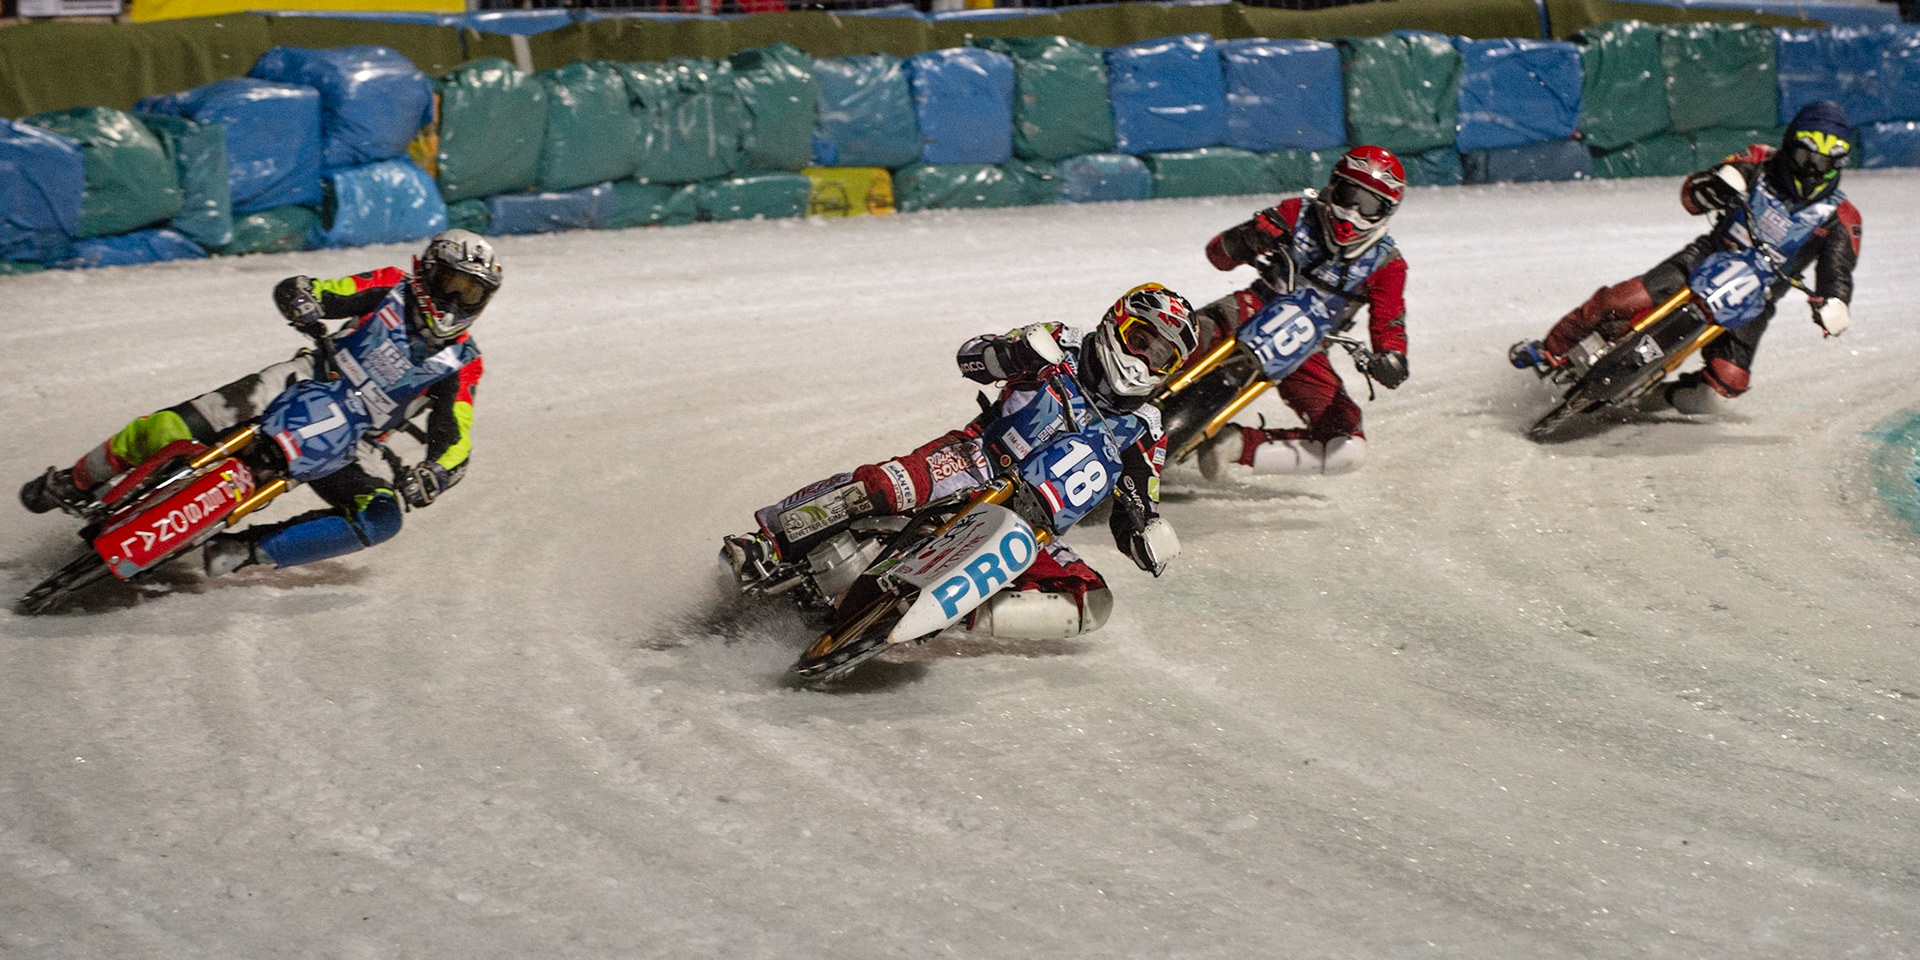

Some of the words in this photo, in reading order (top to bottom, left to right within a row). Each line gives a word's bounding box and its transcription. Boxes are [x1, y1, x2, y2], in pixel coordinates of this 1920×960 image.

[1711, 260, 1761, 306] 14
[1261, 303, 1315, 356] 13
[298, 402, 348, 439] 7
[888, 464, 915, 503] KÄRNTEN
[1050, 439, 1107, 507] 18
[931, 523, 1038, 620] PRO
